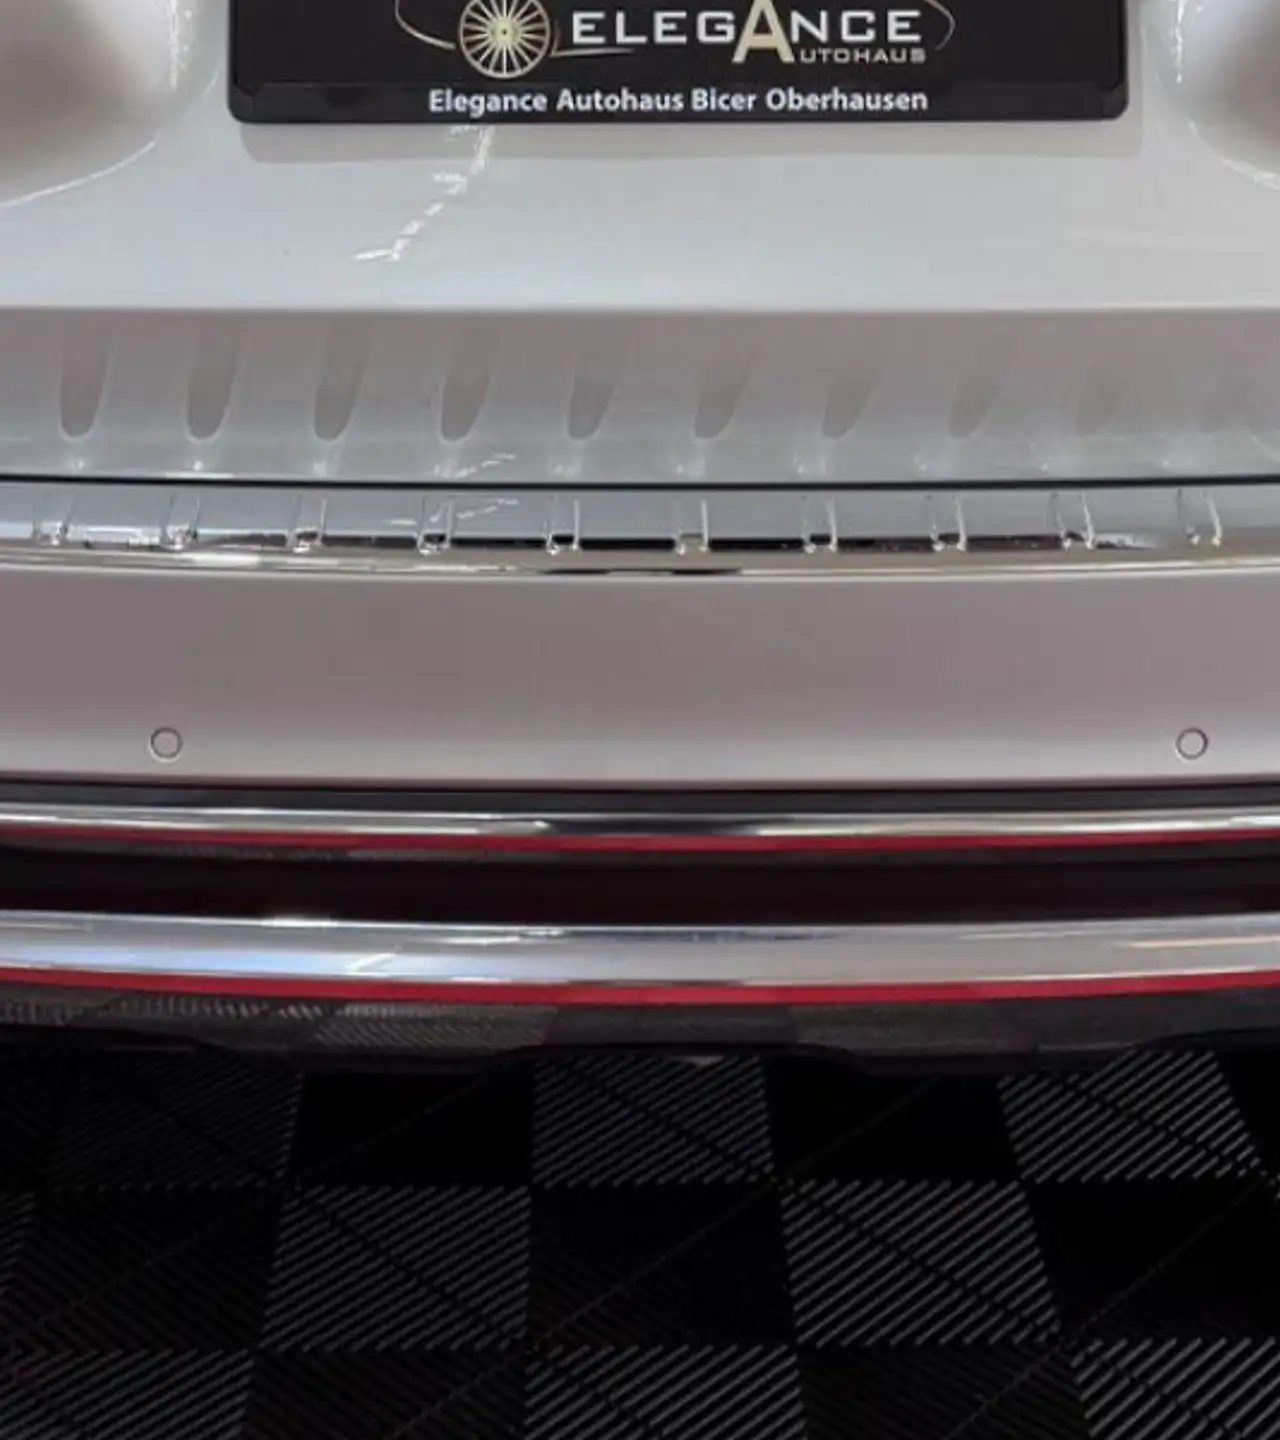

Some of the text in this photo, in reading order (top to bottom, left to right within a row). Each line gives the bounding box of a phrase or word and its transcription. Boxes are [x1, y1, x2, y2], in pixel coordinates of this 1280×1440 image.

[428, 87, 928, 118] Elegance Autohaus Bicer Oberhausen
